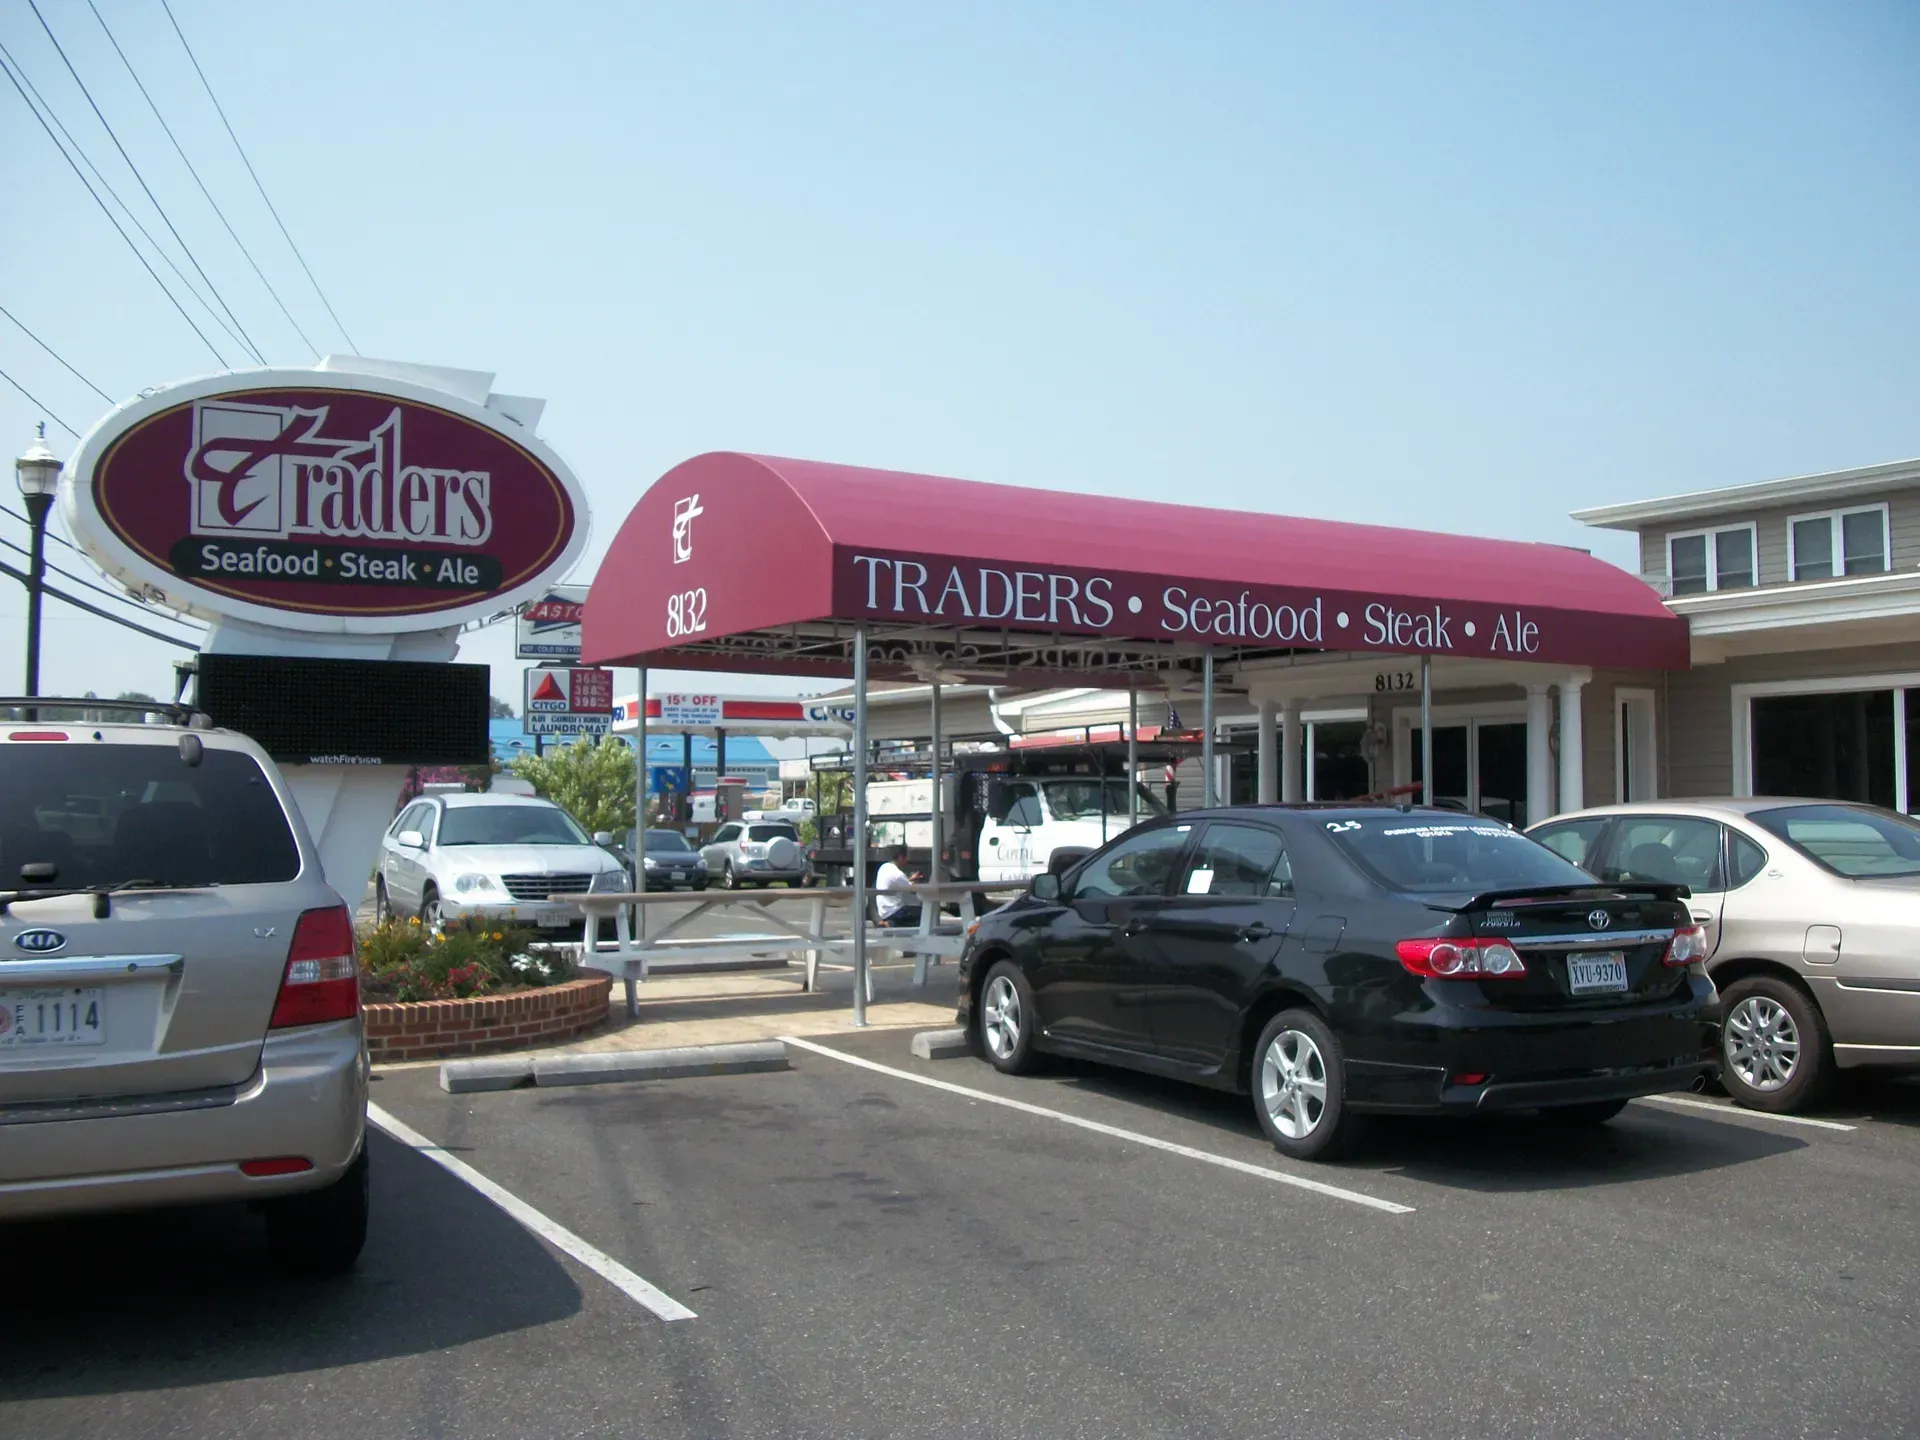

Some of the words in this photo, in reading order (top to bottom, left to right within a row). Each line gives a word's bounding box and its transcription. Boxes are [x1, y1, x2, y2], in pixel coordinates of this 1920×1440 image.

[200, 545, 319, 576] Seafood
[339, 552, 417, 581] Steak
[436, 558, 479, 584] Ale
[667, 587, 707, 637] 8132
[853, 555, 1114, 628] TRADERS
[1161, 586, 1323, 643] Seafood
[1363, 603, 1454, 649] Steak
[1490, 611, 1540, 654] Ale
[1375, 672, 1415, 692] 8132
[532, 701, 567, 710] CITGO
[692, 695, 717, 706] OFF
[532, 725, 607, 733] LAUNDROMAT
[358, 756, 381, 764] SIGNS
[22, 933, 58, 947] KIA
[254, 926, 277, 938] LX
[1572, 963, 1622, 984] XVU-9370
[37, 1000, 99, 1033] 1114
